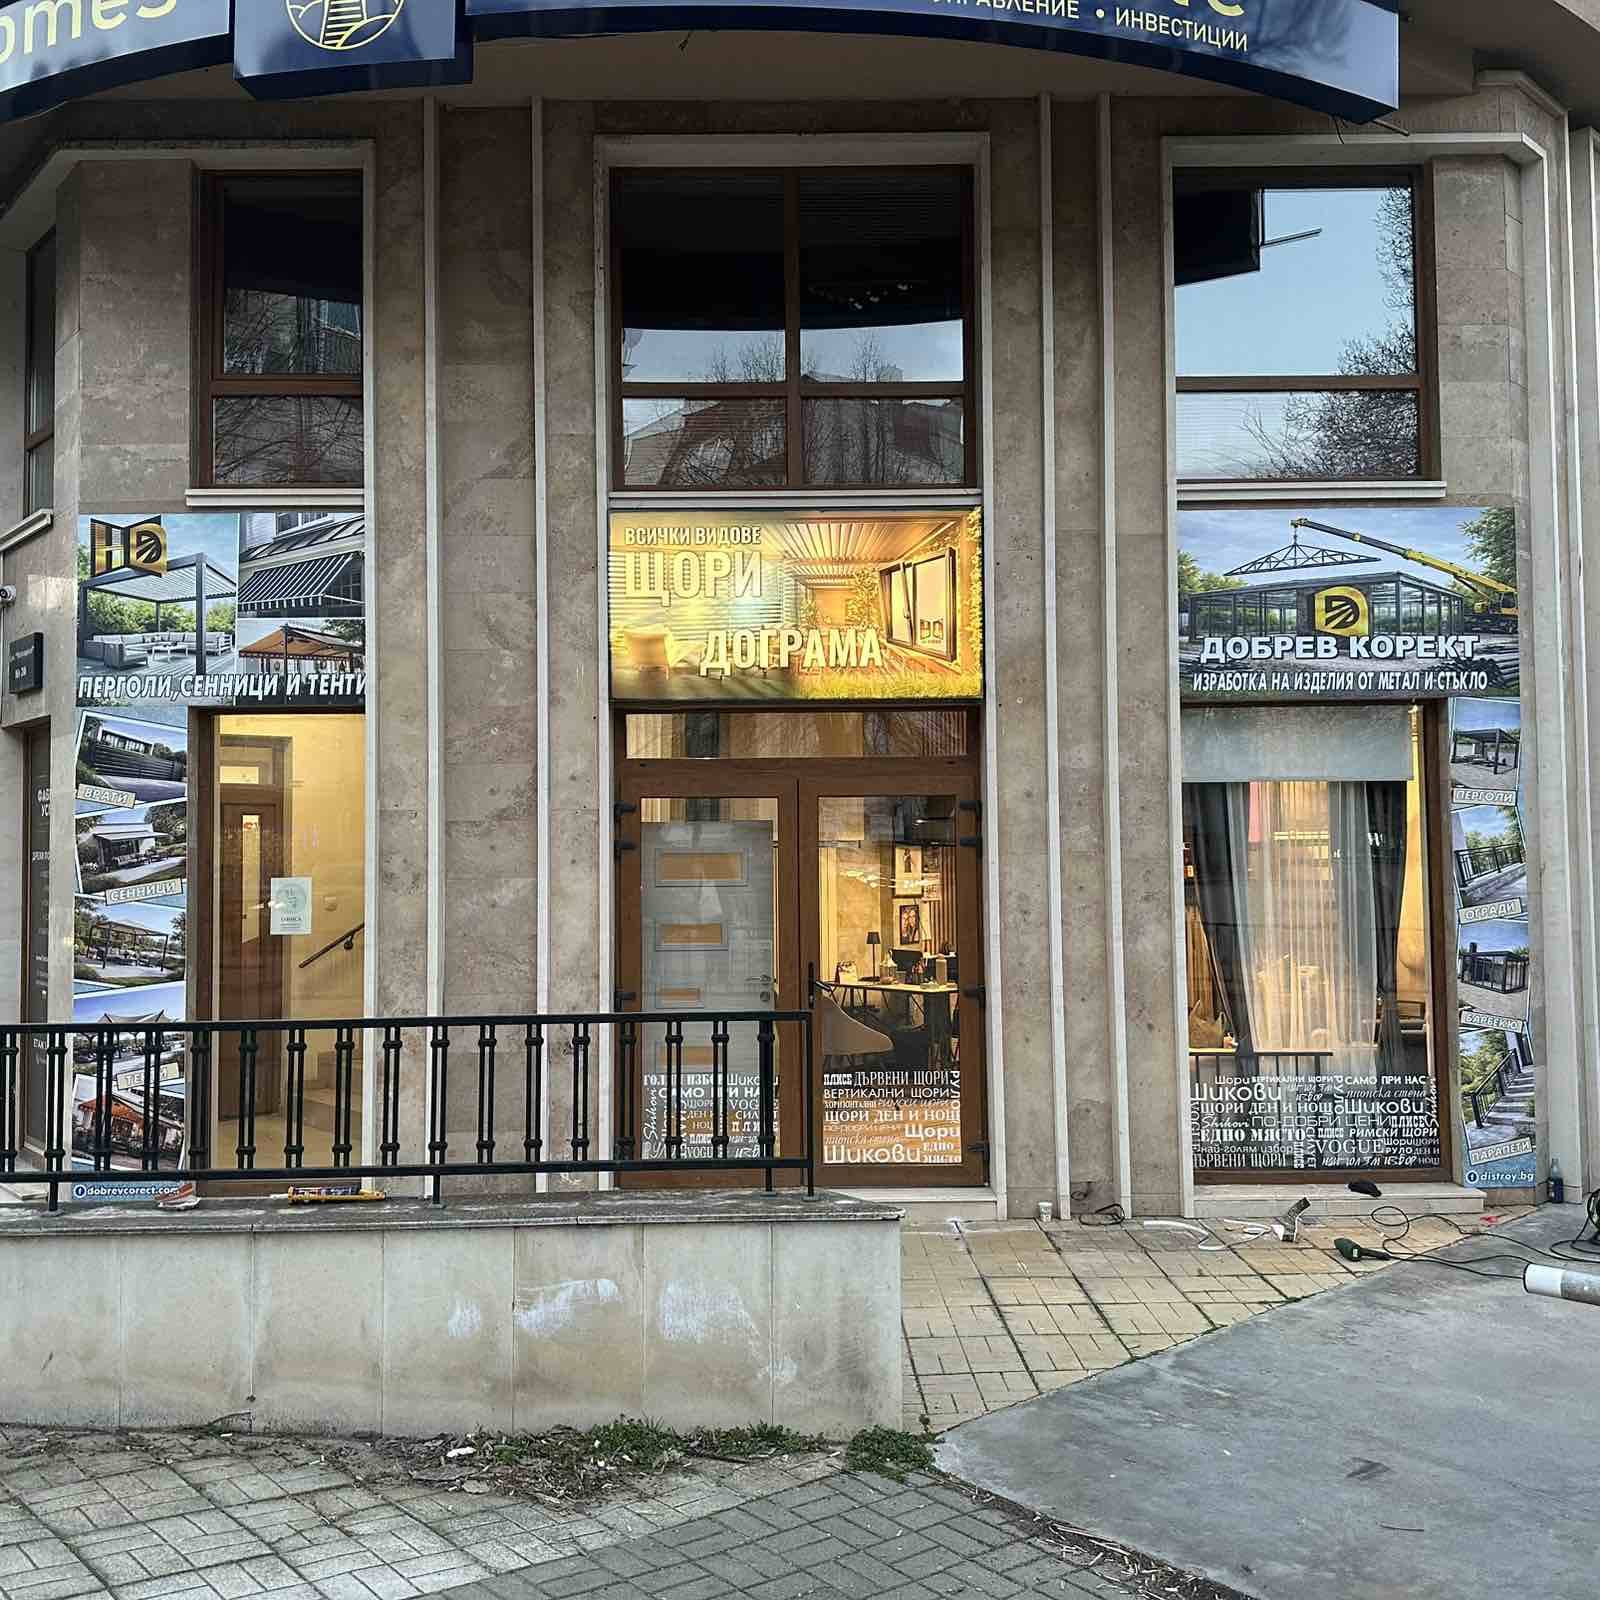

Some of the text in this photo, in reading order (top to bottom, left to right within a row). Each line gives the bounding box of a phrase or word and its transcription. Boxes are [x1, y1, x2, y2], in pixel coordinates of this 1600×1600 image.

[1115, 8, 1248, 52] ИНВЕСТИЦИИ
[625, 526, 761, 546] ВСИЧКИ ВИДОВЕ
[624, 551, 762, 607] ЩОРИ
[700, 629, 884, 677] ДОГРАМА
[1200, 636, 1480, 663] ДОБРЕВ КОРЕКТ
[286, 674, 303, 696] И
[1193, 673, 1267, 691] ИЗРАБОТКА
[1272, 673, 1290, 690] НА
[1294, 672, 1354, 693] ИЗДЕЛИЯ
[1358, 673, 1375, 690] ОТ
[1378, 673, 1420, 690] МЕТАЛ
[84, 788, 129, 804] ВРАТИ
[1456, 789, 1514, 803] ПЕРГОЛИ
[110, 881, 177, 901] СЕННИЦИ
[1464, 904, 1515, 921] ОГРАДИ
[854, 1071, 909, 1087] ДЪРВЕНИ
[913, 1071, 949, 1086] ЩОРИ
[1345, 1075, 1426, 1086] САМО ПРИ НАС
[823, 1087, 950, 1099] ВЕРТИКАЛНИ ЩОРИ
[950, 1070, 961, 1110] РУЛО
[1191, 1082, 1281, 1101] Шикови
[1333, 1075, 1345, 1115] РУЛО
[1200, 1102, 1244, 1116] ЩОРИ
[1248, 1102, 1278, 1115] ДЕН
[1297, 1102, 1333, 1115] НОЩ
[1345, 1097, 1424, 1114] Шикови
[825, 1110, 869, 1124] ЩОРИ
[1252, 1114, 1391, 1130] ПО-ДОБРИ ЦЕНИ
[1391, 1115, 1425, 1128] ПЛИСЕ
[905, 1123, 961, 1140] Щори
[1200, 1128, 1306, 1144] ЕДНО МЯСТО
[1349, 1127, 1438, 1138] РИМСКИ ЩОРИ
[823, 1143, 921, 1164] Шикови
[1261, 1143, 1294, 1155] избор
[1314, 1139, 1384, 1154] VOGUE
[1471, 1143, 1532, 1163] ПАРАПЕТИ
[1250, 1153, 1286, 1168] ЩОРИ
[1480, 1171, 1535, 1186] distroy.bg
